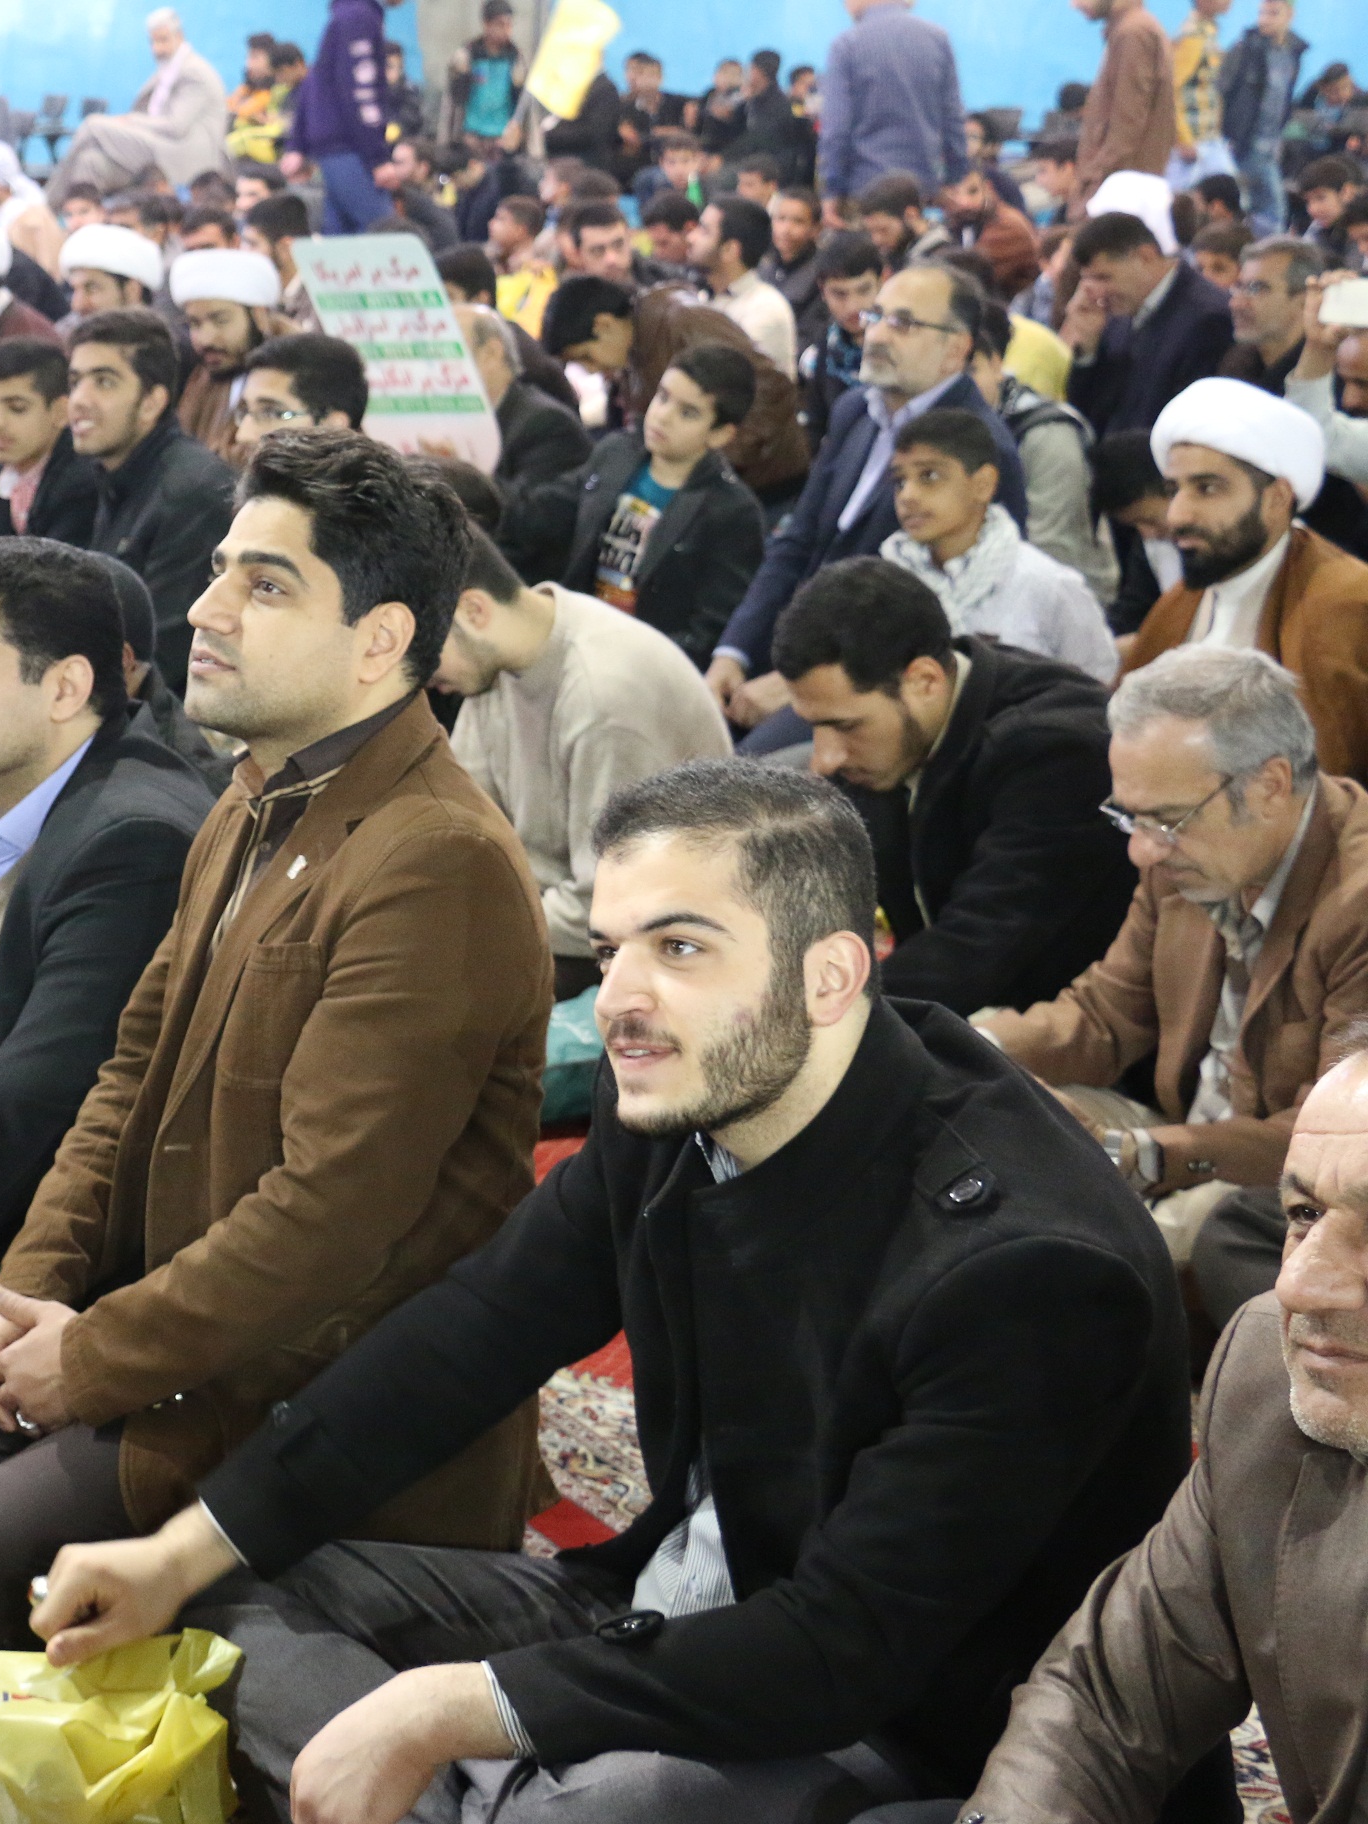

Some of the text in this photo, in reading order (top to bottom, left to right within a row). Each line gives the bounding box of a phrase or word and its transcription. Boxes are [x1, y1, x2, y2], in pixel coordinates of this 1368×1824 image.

[387, 256, 421, 282] مرگ
[412, 310, 448, 338] مرگ
[368, 366, 412, 392] انگلی
[439, 364, 470, 393] مرگ
